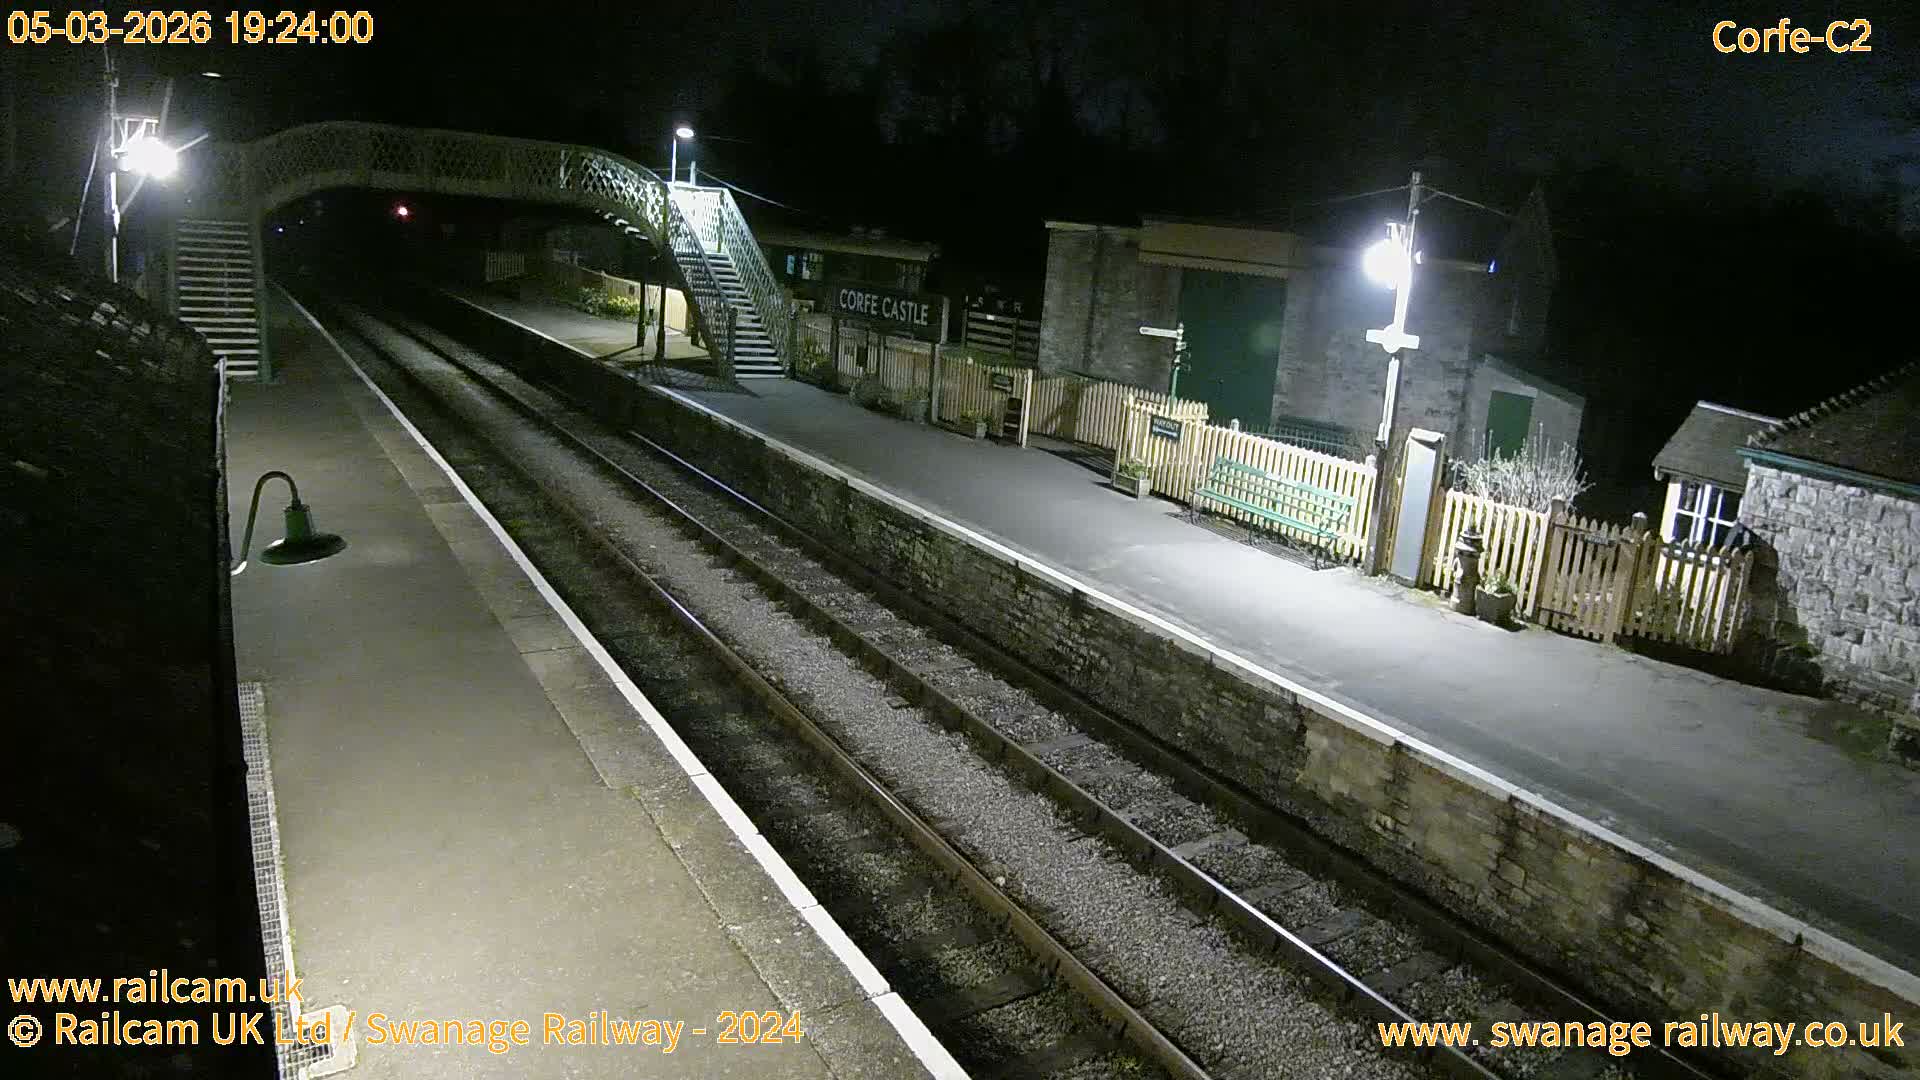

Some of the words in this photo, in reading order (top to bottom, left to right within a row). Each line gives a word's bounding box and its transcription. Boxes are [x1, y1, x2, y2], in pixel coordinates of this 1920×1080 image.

[840, 289, 880, 316] CORFE
[882, 297, 929, 326] CASTLE
[1166, 421, 1179, 431] OUT
